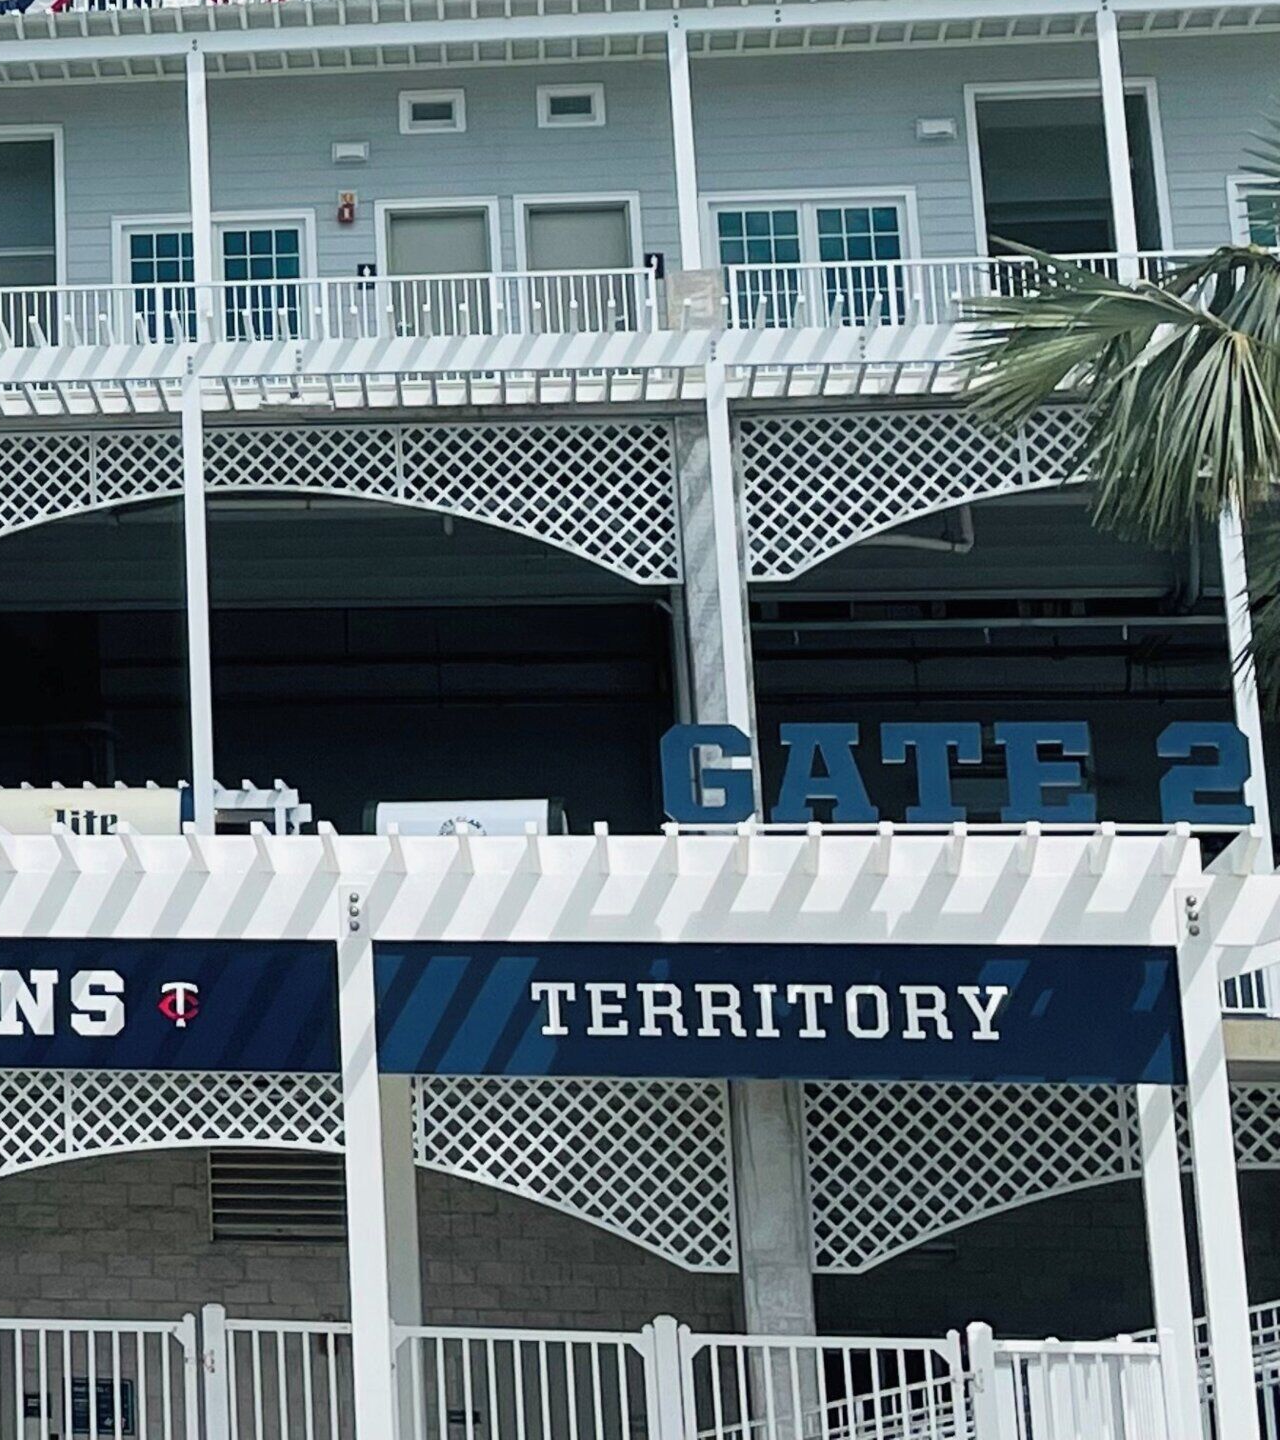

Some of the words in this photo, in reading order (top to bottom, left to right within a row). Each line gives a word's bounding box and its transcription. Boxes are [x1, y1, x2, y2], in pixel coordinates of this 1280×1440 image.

[660, 721, 1097, 824] GATE
[1156, 721, 1256, 824] 2
[531, 982, 1009, 1041] TERRITORY
